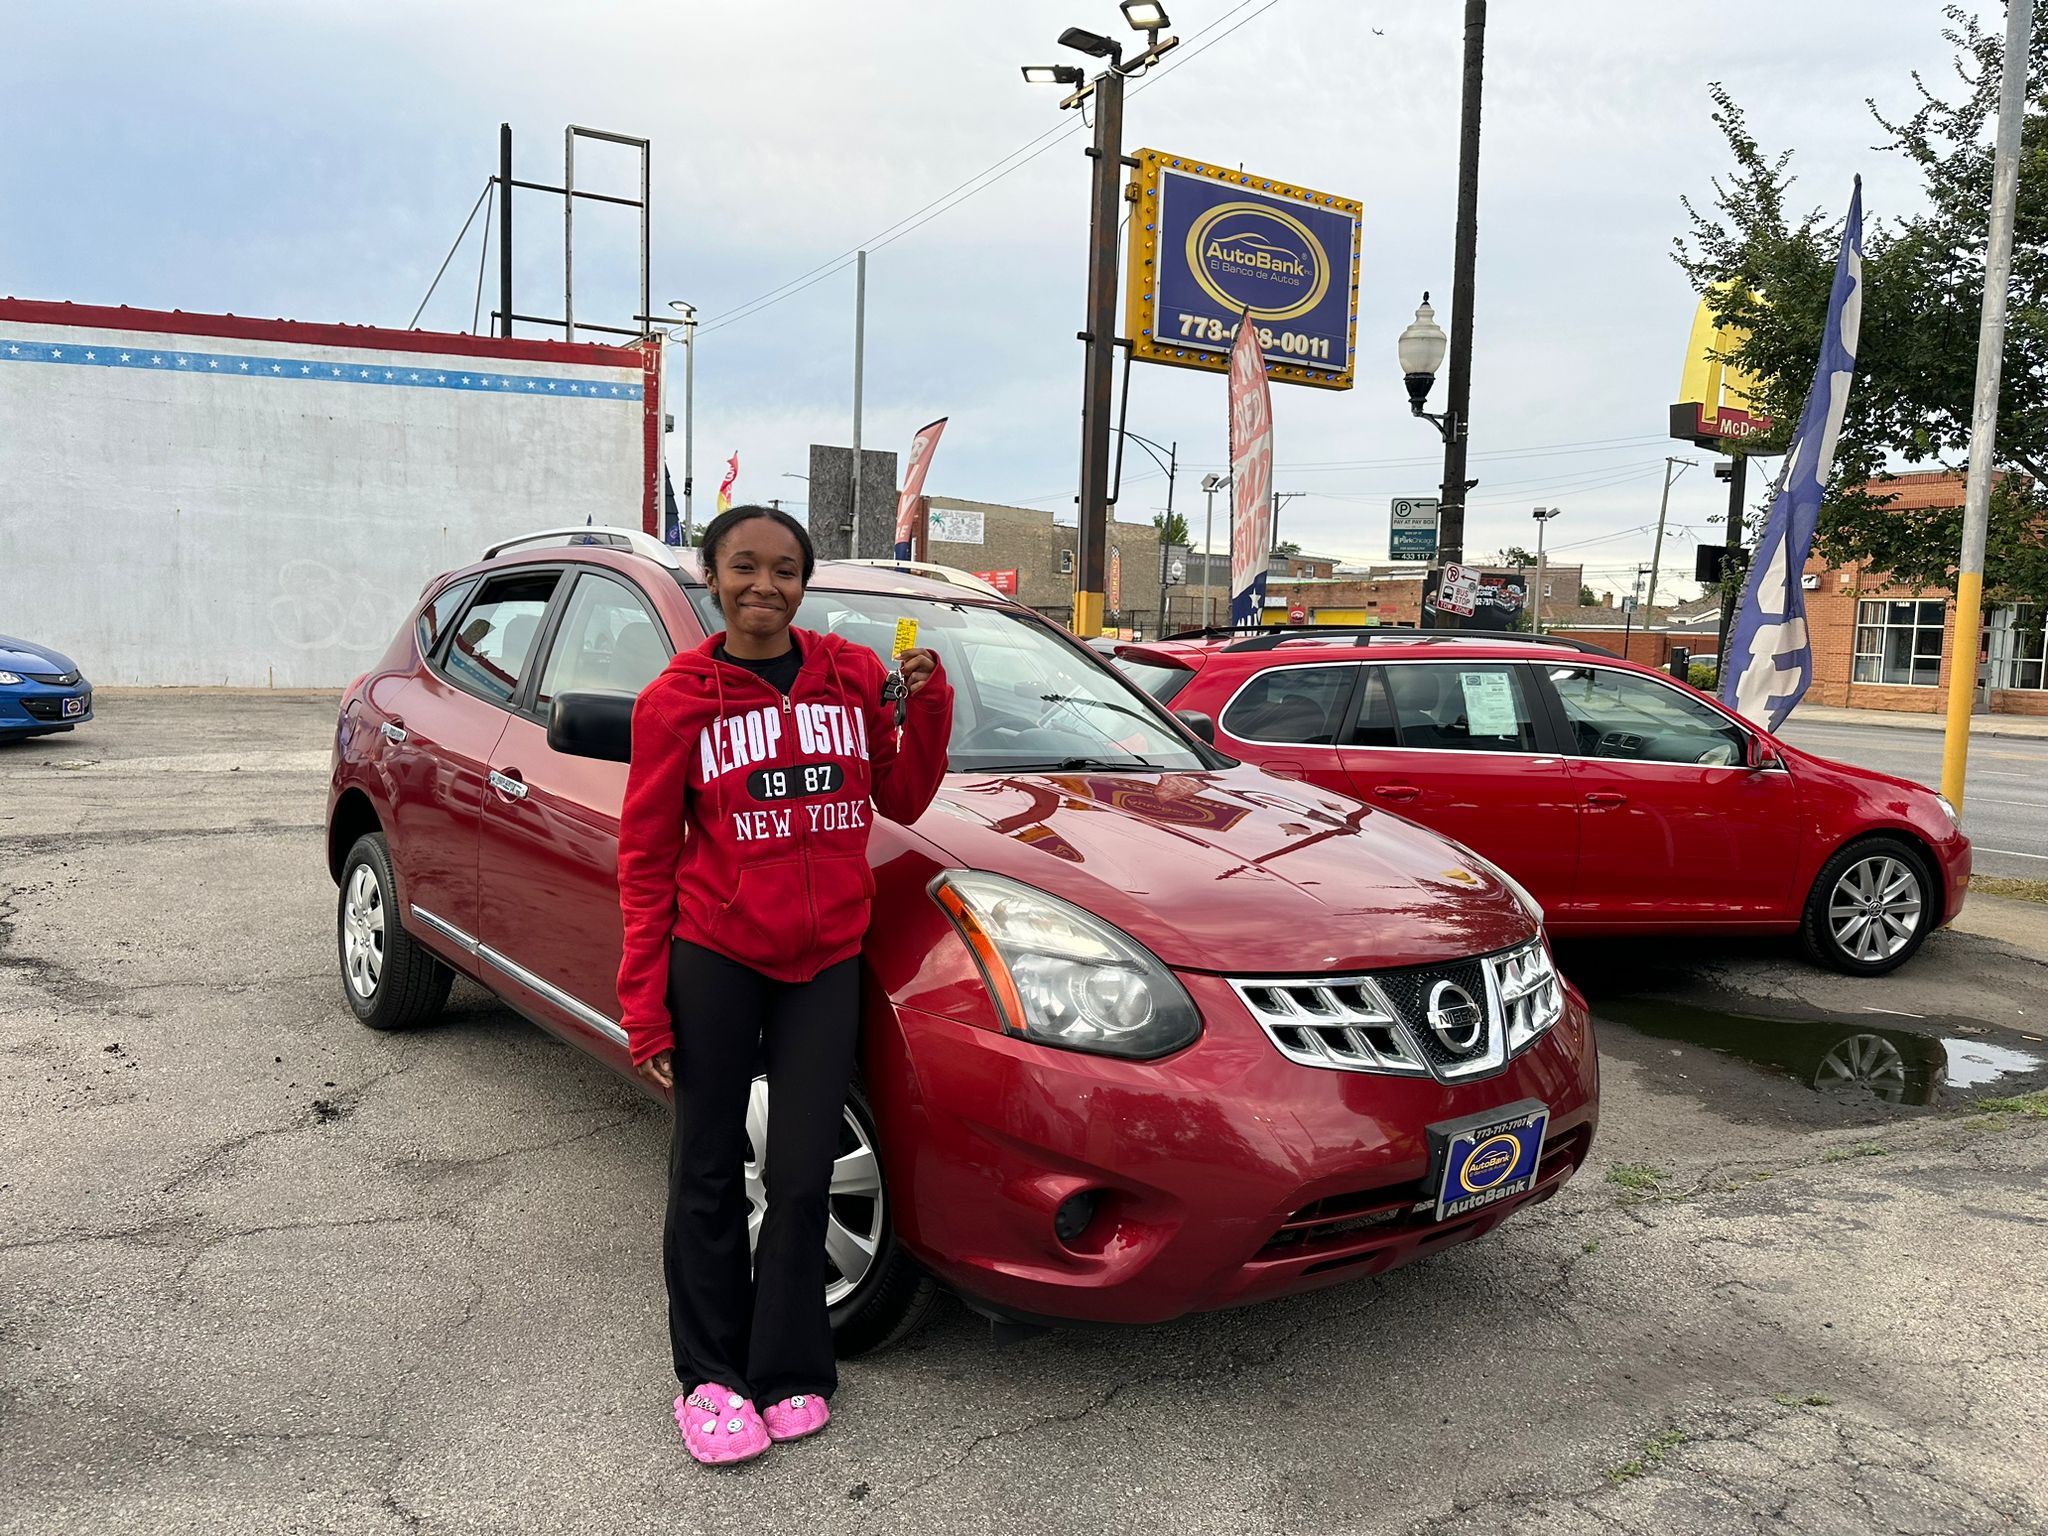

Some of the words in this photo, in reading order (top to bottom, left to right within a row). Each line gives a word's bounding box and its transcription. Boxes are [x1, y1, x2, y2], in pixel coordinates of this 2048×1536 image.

[1206, 241, 1304, 277] AutoBank
[1210, 259, 1220, 270] El
[1222, 262, 1254, 277] Banco
[1255, 270, 1268, 280] de
[1270, 272, 1300, 287] Autos
[1178, 313, 1329, 360] 773-8-0011
[1237, 446, 1270, 520] BAD
[1440, 601, 1453, 610] TOW
[1455, 606, 1470, 615] ZONE
[1454, 596, 1470, 605] STOP
[1455, 588, 1469, 598] BUS
[762, 771, 787, 798] 19
[804, 765, 832, 792] 87
[732, 808, 792, 842] NEW
[805, 800, 865, 833] YORK
[1476, 1117, 1527, 1140] 773-717-7707
[1468, 1153, 1511, 1173] AutoBank
[1446, 1180, 1526, 1217] AutoBank
